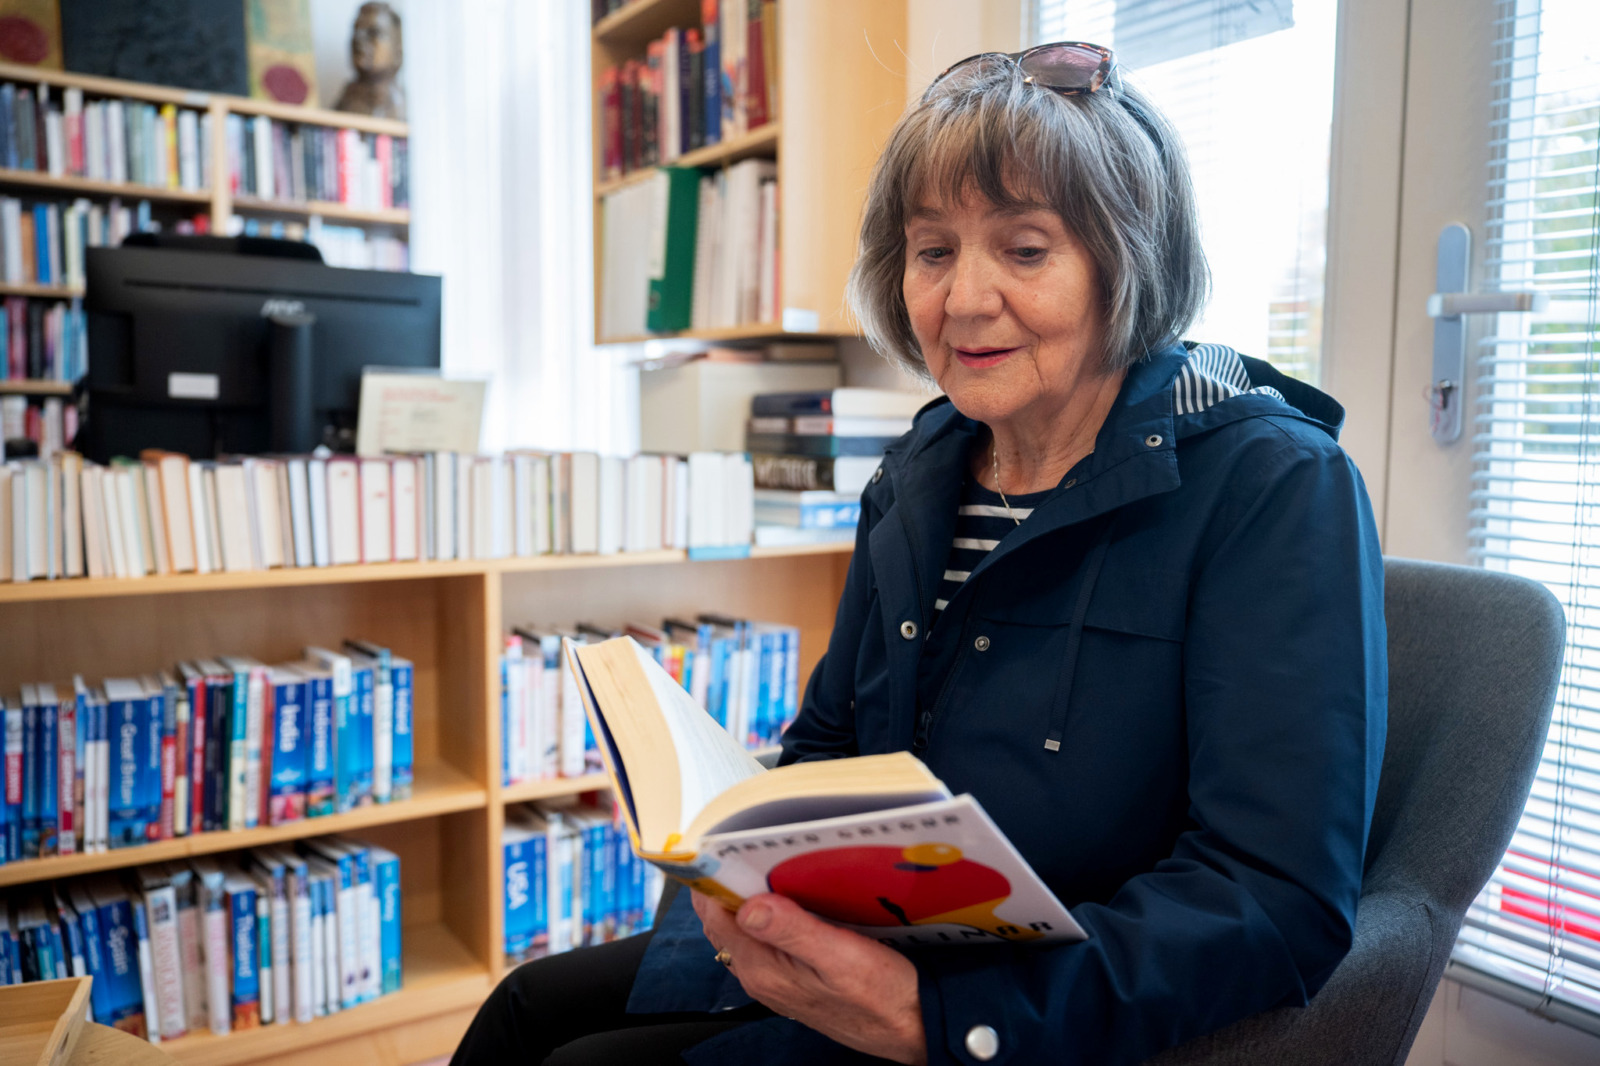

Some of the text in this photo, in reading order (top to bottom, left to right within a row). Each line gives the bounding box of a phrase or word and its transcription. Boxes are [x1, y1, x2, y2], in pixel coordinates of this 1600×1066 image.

[120, 723, 138, 760] Great
[279, 704, 301, 752] India
[507, 861, 530, 910] USA
[106, 925, 130, 975] Spain
[236, 914, 254, 977] Thailand
